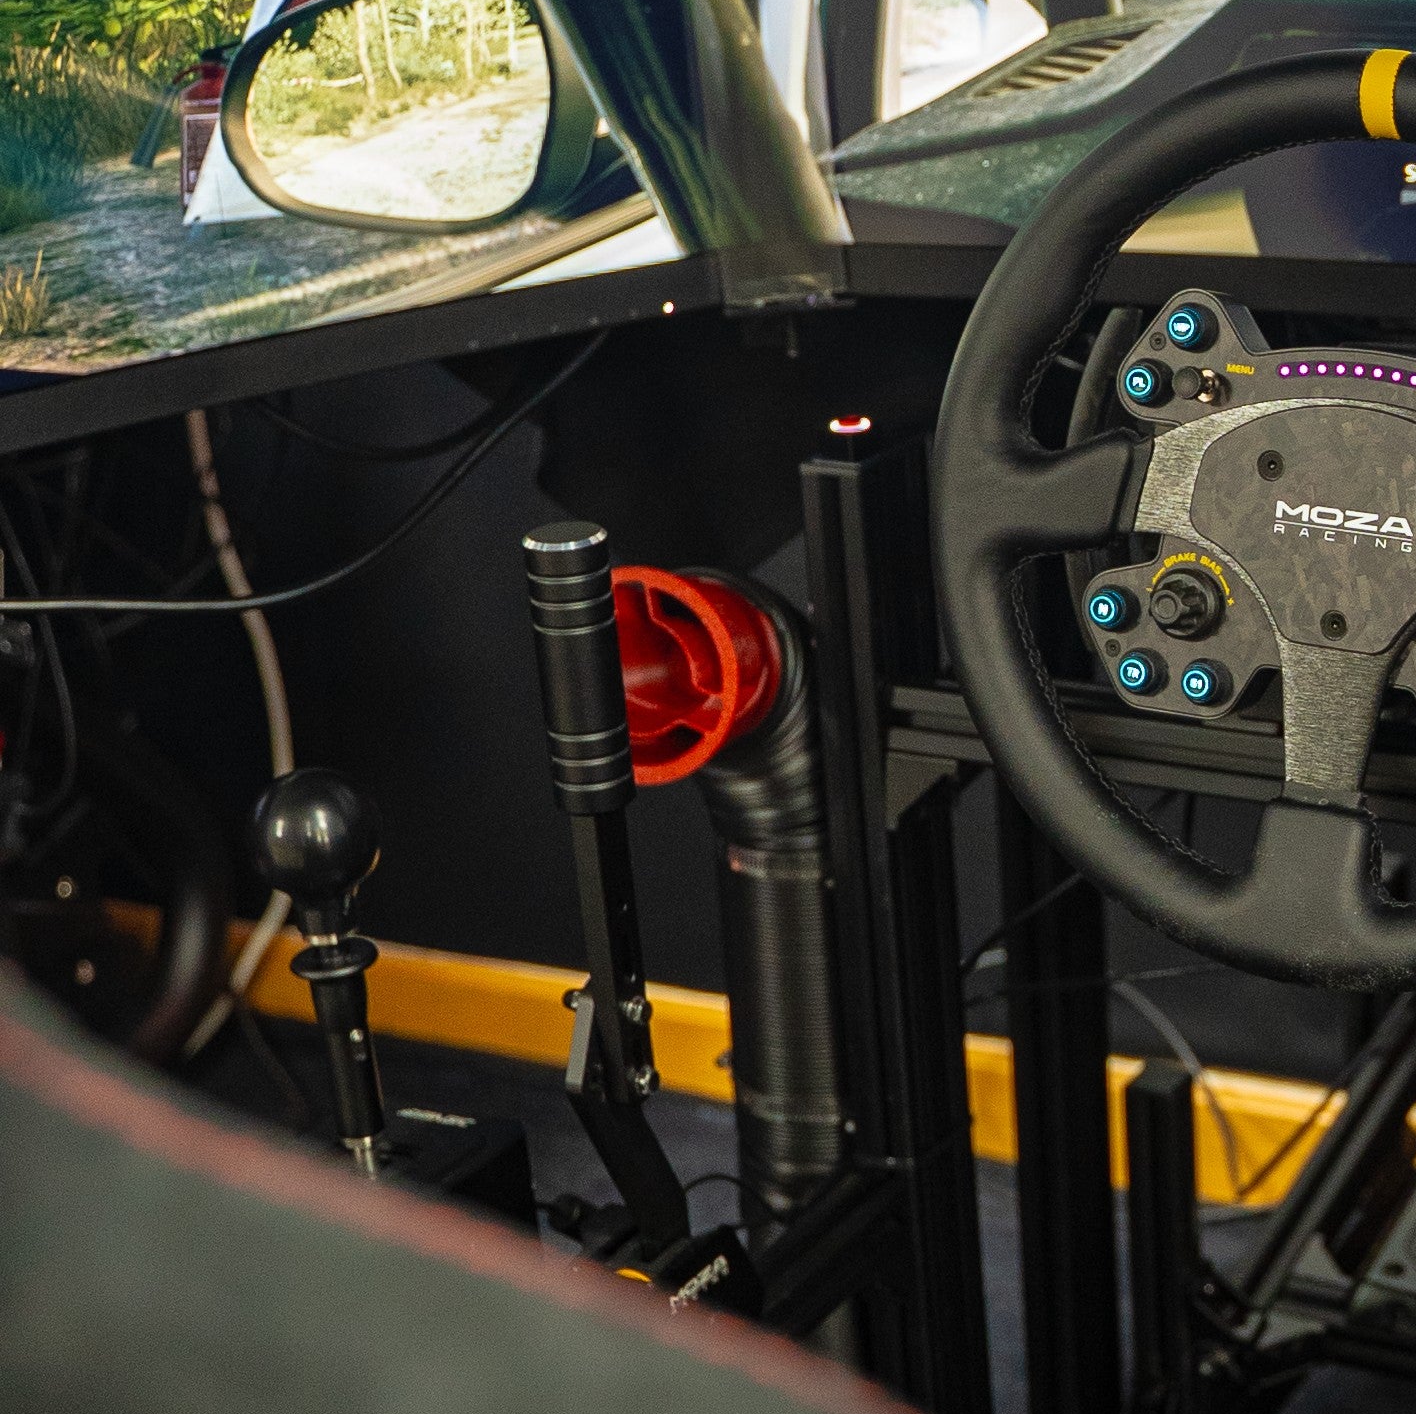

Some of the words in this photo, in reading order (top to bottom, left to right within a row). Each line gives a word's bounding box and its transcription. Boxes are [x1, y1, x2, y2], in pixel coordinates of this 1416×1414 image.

[1226, 364, 1255, 375] MENU
[1275, 500, 1414, 537] MOZA
[1274, 523, 1413, 553] RACING
[1163, 552, 1197, 568] BRAKE
[1200, 555, 1223, 575] BIAS
